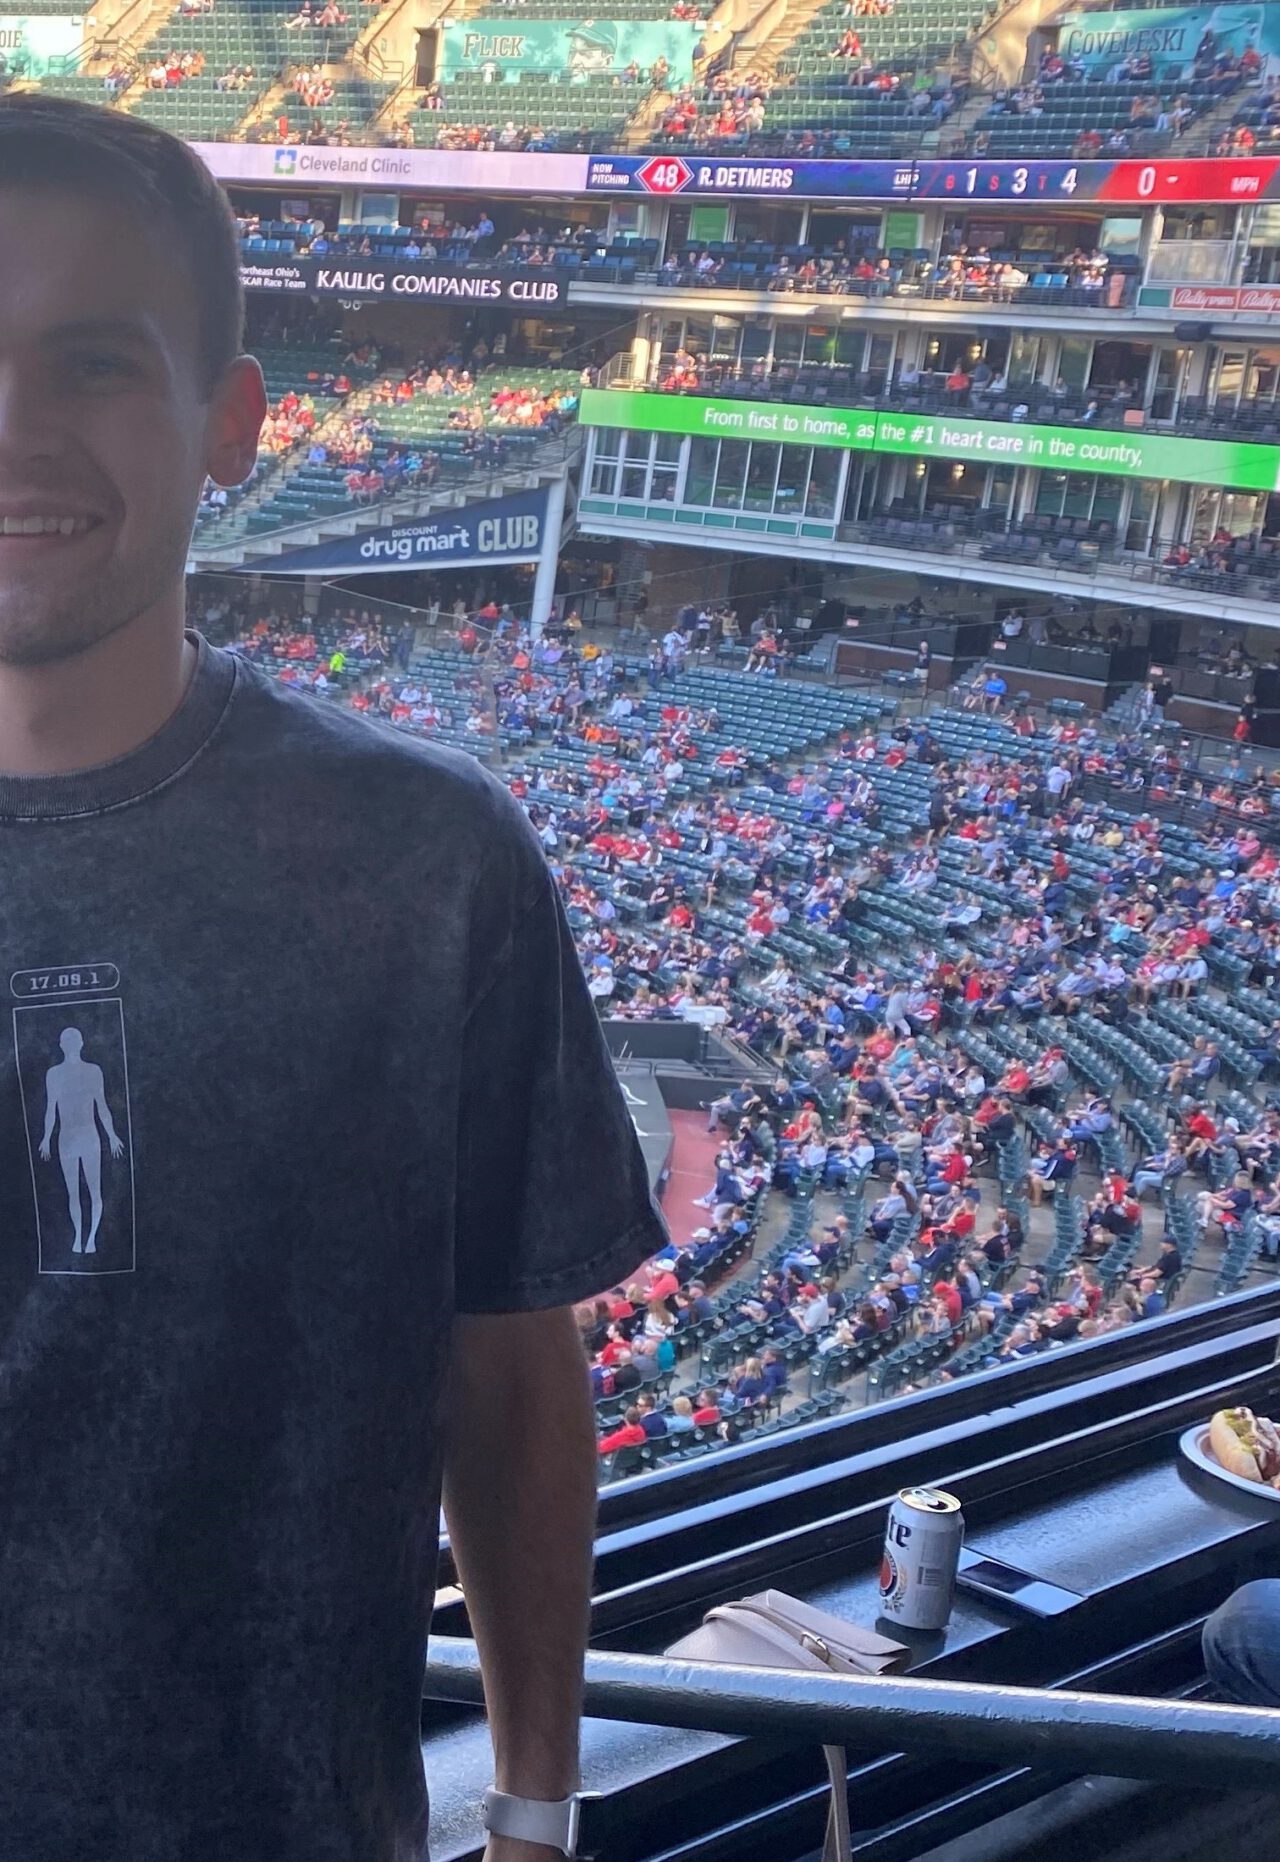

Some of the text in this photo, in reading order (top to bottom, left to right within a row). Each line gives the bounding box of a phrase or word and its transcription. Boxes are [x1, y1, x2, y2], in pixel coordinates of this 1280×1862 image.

[463, 32, 525, 58] FLICK
[1067, 27, 1188, 57] COVELESKI
[300, 155, 412, 174] Cleveland Clinic
[592, 163, 613, 173] NOW
[651, 164, 679, 188] 48
[591, 174, 630, 184] PITCHING
[698, 167, 794, 188] R. DETMERS
[966, 168, 978, 193] 1
[1011, 167, 1028, 194] 3
[1060, 168, 1078, 193] 4
[1137, 166, 1156, 197] 0
[1230, 177, 1260, 192] MPH
[264, 278, 282, 287] Race
[284, 279, 306, 289] Team
[275, 268, 300, 277] Ohio's
[317, 270, 558, 300] KAULIG COMPANIES CLUB
[704, 407, 1143, 467] From first to home, as the #1 heart care in the country,
[360, 515, 539, 560] drug mart CLUB
[391, 525, 438, 537] DISCOUNT
